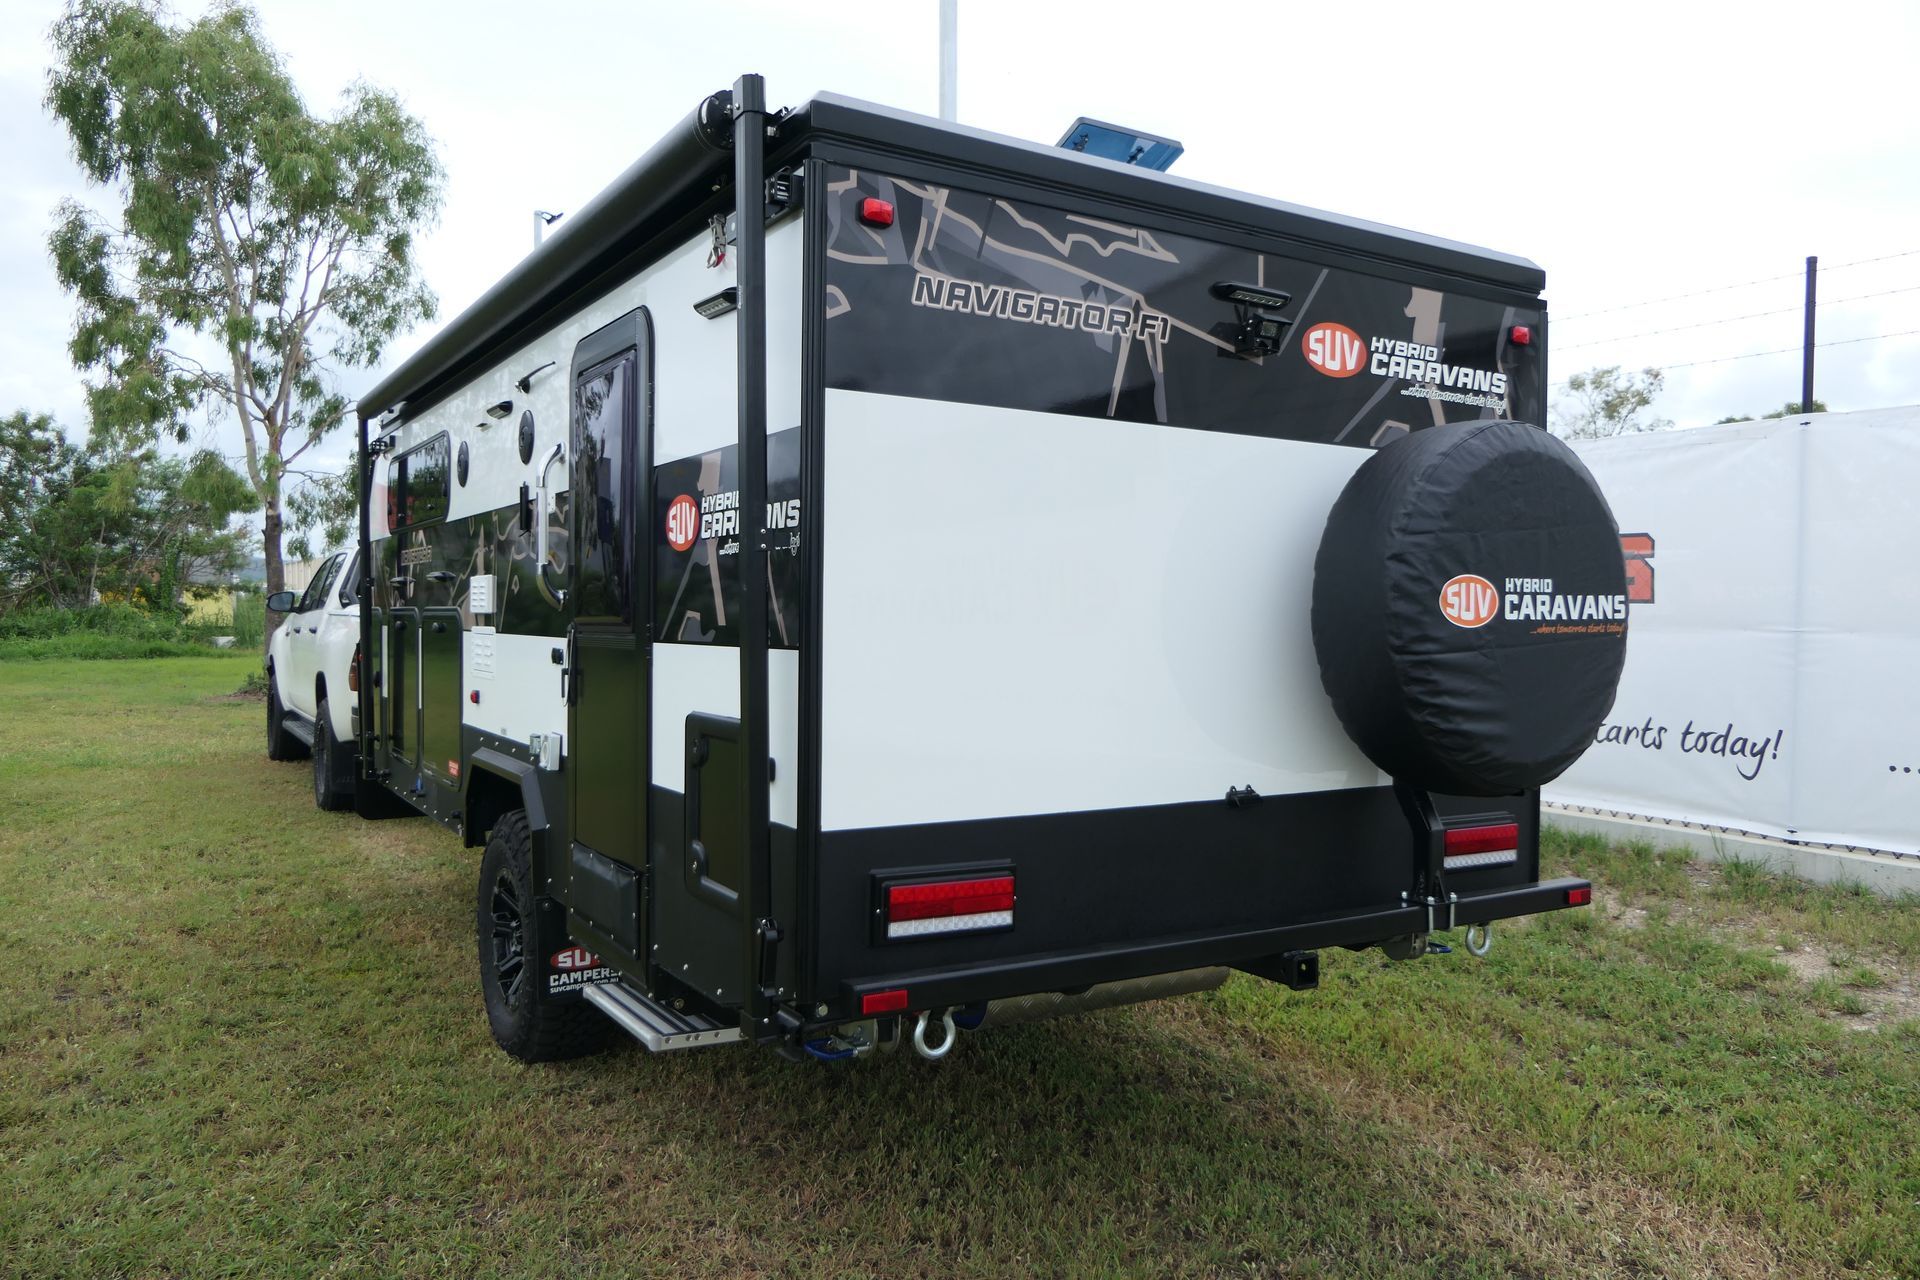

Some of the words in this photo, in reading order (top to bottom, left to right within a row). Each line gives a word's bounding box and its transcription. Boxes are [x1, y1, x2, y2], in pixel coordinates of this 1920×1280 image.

[911, 271, 1134, 336] NAVIGATOR
[1136, 312, 1171, 344] F1
[1307, 328, 1361, 373] SUV
[1370, 336, 1438, 362] HYBRID
[1370, 353, 1508, 394] CARAVANS
[667, 501, 696, 546] SUV
[701, 498, 801, 539] CARNS
[1446, 582, 1493, 622] SUV
[1504, 577, 1553, 593] HYBRID
[1504, 594, 1626, 621] CARAVANS
[1595, 716, 1668, 750] tarts
[1680, 719, 1784, 781] today!
[557, 949, 593, 968] SU
